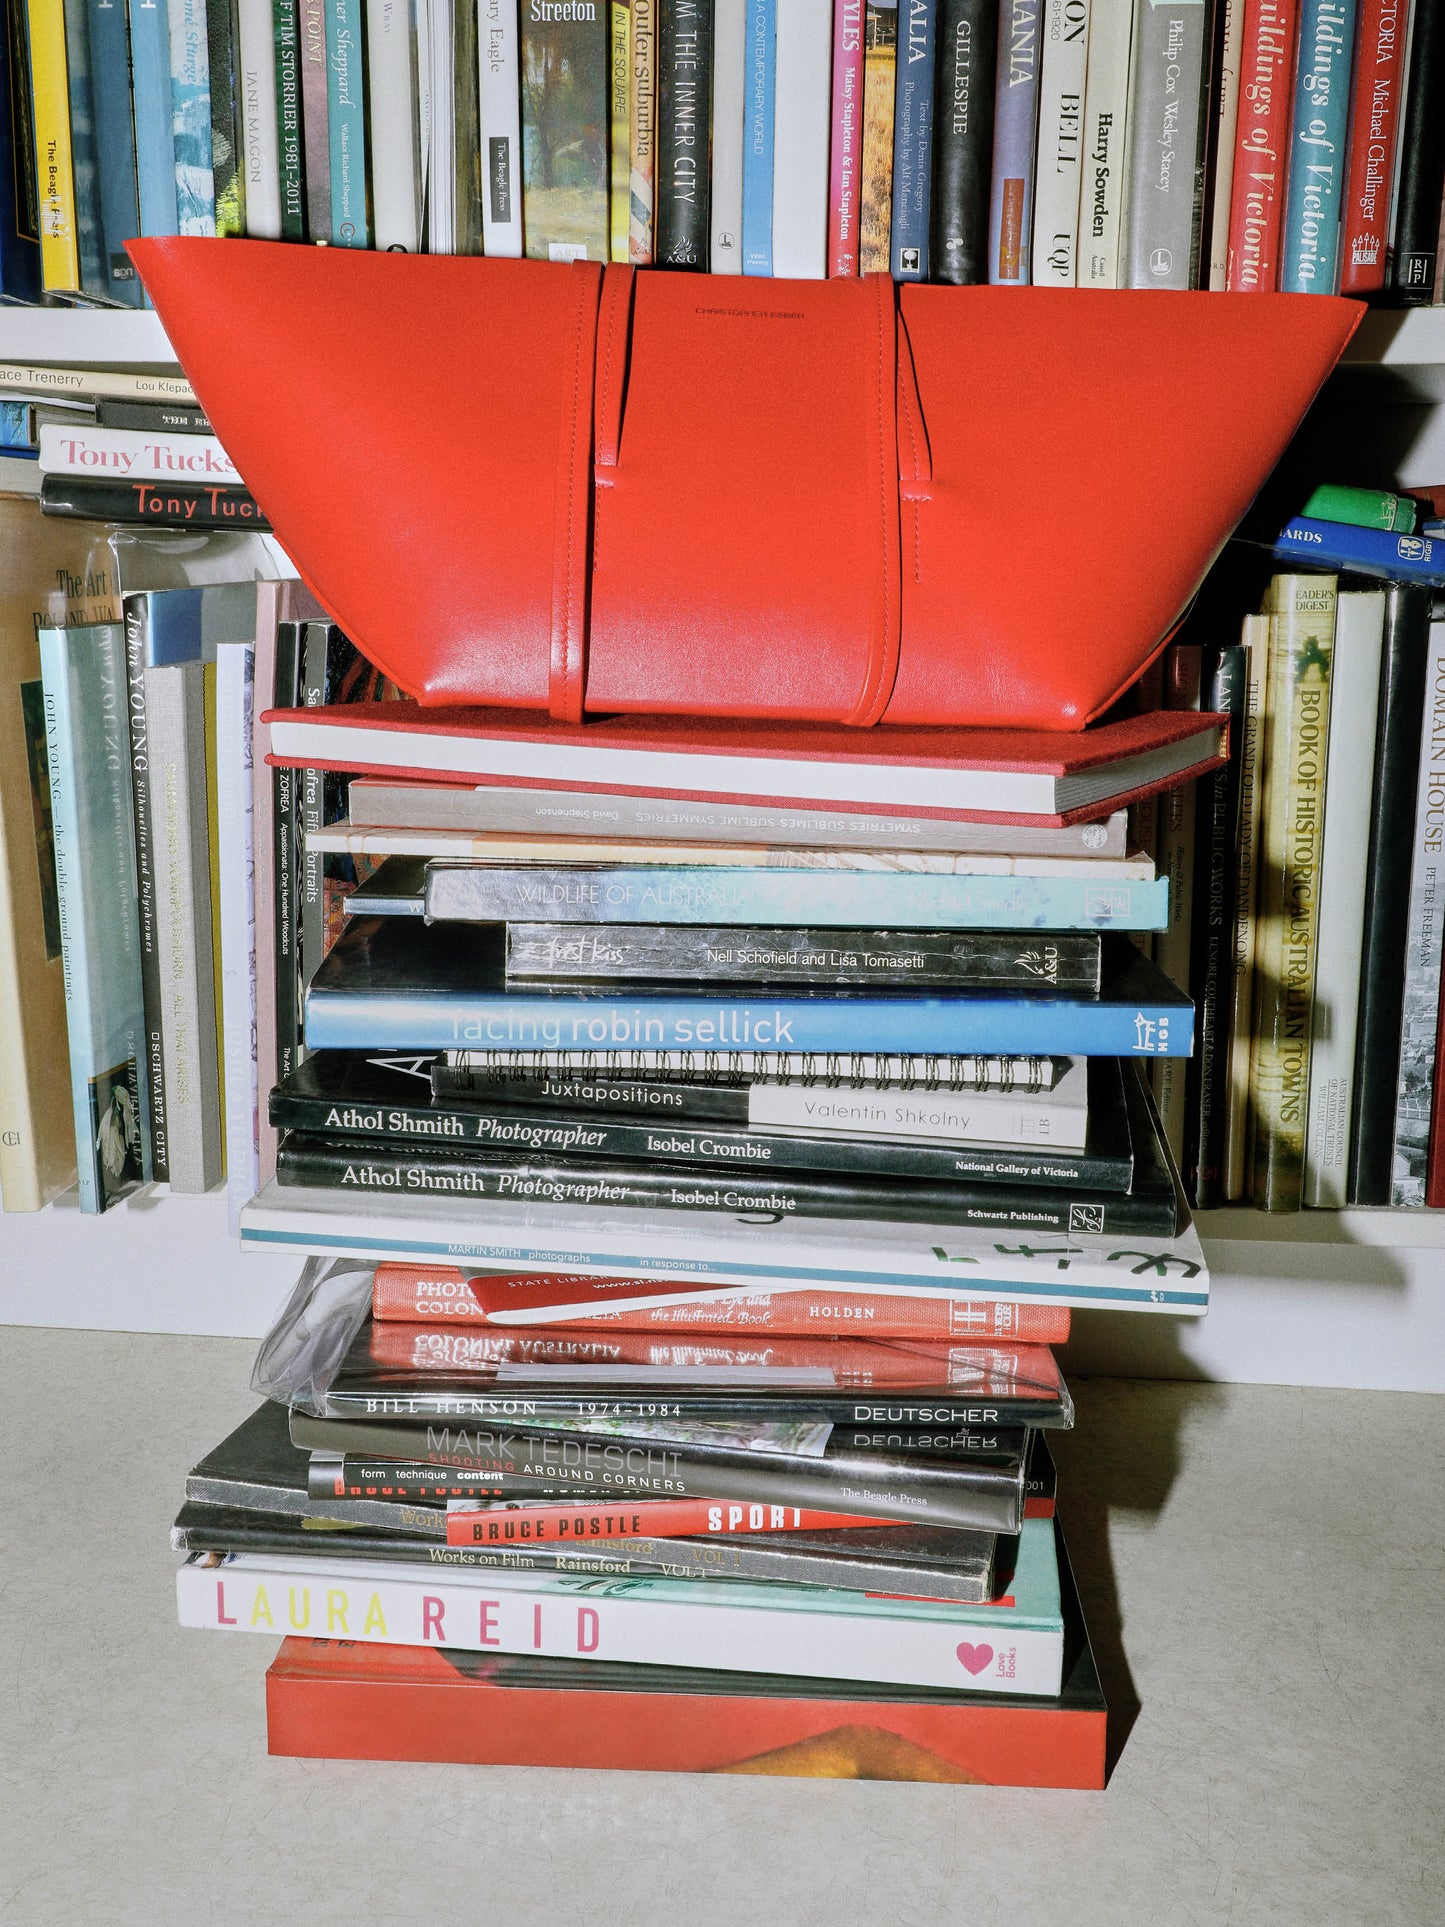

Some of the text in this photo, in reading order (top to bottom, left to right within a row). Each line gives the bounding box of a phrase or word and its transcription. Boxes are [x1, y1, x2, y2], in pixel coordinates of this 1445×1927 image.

[530, 0, 596, 23] Streeton
[184, 33, 199, 83] Sturge
[281, 13, 297, 131] TIM STORRIER
[332, 30, 356, 109] Sheppard
[488, 29, 505, 73] Eagle
[614, 11, 626, 113] IN THE SQUARE
[634, 0, 654, 156] Outer Suburbia
[754, 16, 767, 155] CONTEMPORARY WORLD
[954, 20, 971, 134] GILLESPIE
[246, 71, 262, 184] JANE MAGON
[674, 30, 697, 204] THE INNER CITY
[900, 82, 915, 162] Photography by
[1156, 20, 1183, 193] Philip Cox Wesley Stacey
[47, 140, 57, 162] The
[498, 143, 506, 160] The
[838, 68, 856, 241] Maisy Stapleton & Ian Stapleton
[1057, 94, 1081, 174] BELL
[1360, 79, 1391, 222] Michael Challinger
[496, 161, 507, 190] Beagle
[914, 100, 929, 214] Text by Denis Gregory
[1092, 113, 1113, 238] Harry Sowden
[1242, 128, 1277, 285] of Victoria
[1298, 118, 1335, 281] of Victoria
[1048, 234, 1071, 278] UQP
[695, 307, 768, 318] CHRISTOPHER
[28, 370, 155, 391] Trenerry Lou
[60, 440, 138, 474] Tony
[132, 484, 197, 519] Tony
[1424, 540, 1433, 562] RIGBY
[56, 570, 107, 598] The Art
[1296, 600, 1329, 611] DIGEST
[126, 612, 153, 953] John YOUNG Silhouettes and Polychromes
[280, 774, 289, 813] ZOFREA
[536, 808, 921, 833] SYMETRIES SUBLIMES SUBLIME SYMMETRIES David Stephenson
[1234, 680, 1260, 976] THE GRAND DANDENONG
[1420, 656, 1445, 968] DOMAIN HOUSE PETER FREEMAN
[44, 693, 73, 1002] JOHN YOUNG the double ground paintings
[516, 884, 749, 906] WILDLIFE OF AUSTRALIA
[1208, 870, 1224, 925] WORKS
[1280, 690, 1321, 1122] BOOK OF HISTORIC AUSTRALIAN TOWNS
[707, 950, 925, 969] Nell Schofield and Lisa Tomasetti
[1044, 946, 1058, 984] A&U
[452, 1008, 795, 1049] facing robin sellick
[1158, 1017, 1169, 1052] HGB
[152, 1043, 167, 1168] SCHWARTZ CITY
[542, 1080, 683, 1106] Juxtapositions
[805, 1102, 971, 1130] Valentin Shkolny
[1326, 1078, 1338, 1168] OF NATIONAL TRUSTS
[1334, 1078, 1348, 1168] AUSTRALIAN COUNCIL
[325, 1108, 1079, 1178] Athol Shmith Photographer Isobel Crombie National Gallery of Victoria
[342, 1166, 1060, 1224] Athol Shmith Photographer Isobel Crombie Schwartz Publishing
[448, 1244, 696, 1272] MARTIN SMITH photographs in response
[508, 1278, 552, 1288] STATE
[651, 1310, 736, 1324] the Illustrated
[810, 1306, 875, 1319] HOLDEN
[366, 1400, 999, 1423] BILL HENSON DEUTSCHER
[427, 1426, 682, 1478] MARK TEDESCHI
[361, 1469, 505, 1484] form technique content
[428, 1452, 928, 1506] SHOOTING AROUND CORNERS The Beagle Press
[472, 1515, 642, 1541] BRUCE POSTLE
[428, 1549, 698, 1578] Works on Film Rainsford VOL
[692, 1550, 728, 1565] VOL
[217, 1580, 601, 1653] LAURA REID
[996, 1652, 1006, 1678] Love
[1006, 1647, 1017, 1679] Books
